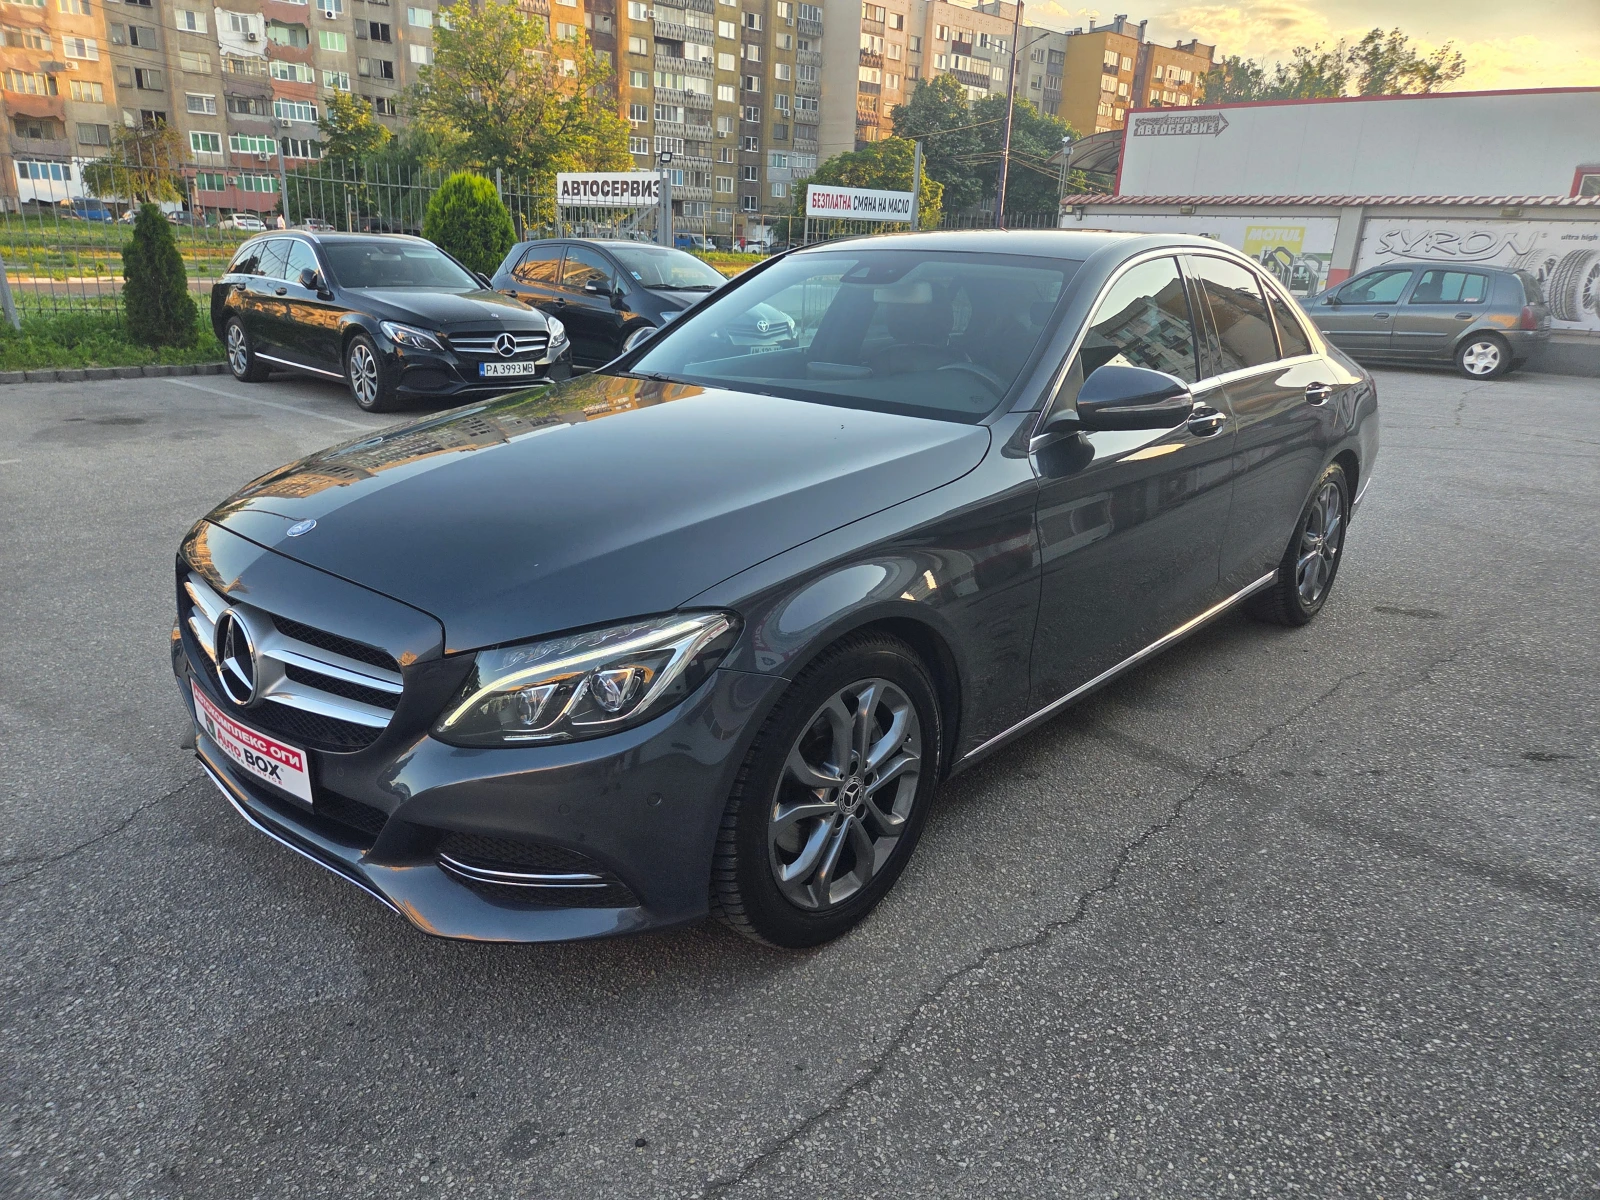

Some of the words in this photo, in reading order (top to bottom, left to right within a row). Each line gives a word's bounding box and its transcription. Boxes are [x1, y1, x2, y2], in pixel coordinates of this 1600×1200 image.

[1137, 121, 1217, 136] АВТОСЕРВИЗ
[561, 180, 660, 198] АВТОСЕРВИЗ
[812, 192, 851, 210] БЕЗПЛАТНА
[853, 195, 876, 213] СМЯНА
[878, 197, 886, 213] НА
[887, 198, 909, 214] МАСЛО
[1247, 228, 1301, 242] MOTUL
[1375, 229, 1538, 256] SYRON
[1581, 234, 1598, 242] high
[486, 364, 498, 375] PA
[500, 364, 521, 374] 3993
[523, 363, 534, 373] MB
[243, 747, 282, 781] BOX
[270, 746, 300, 768] ОГИ
